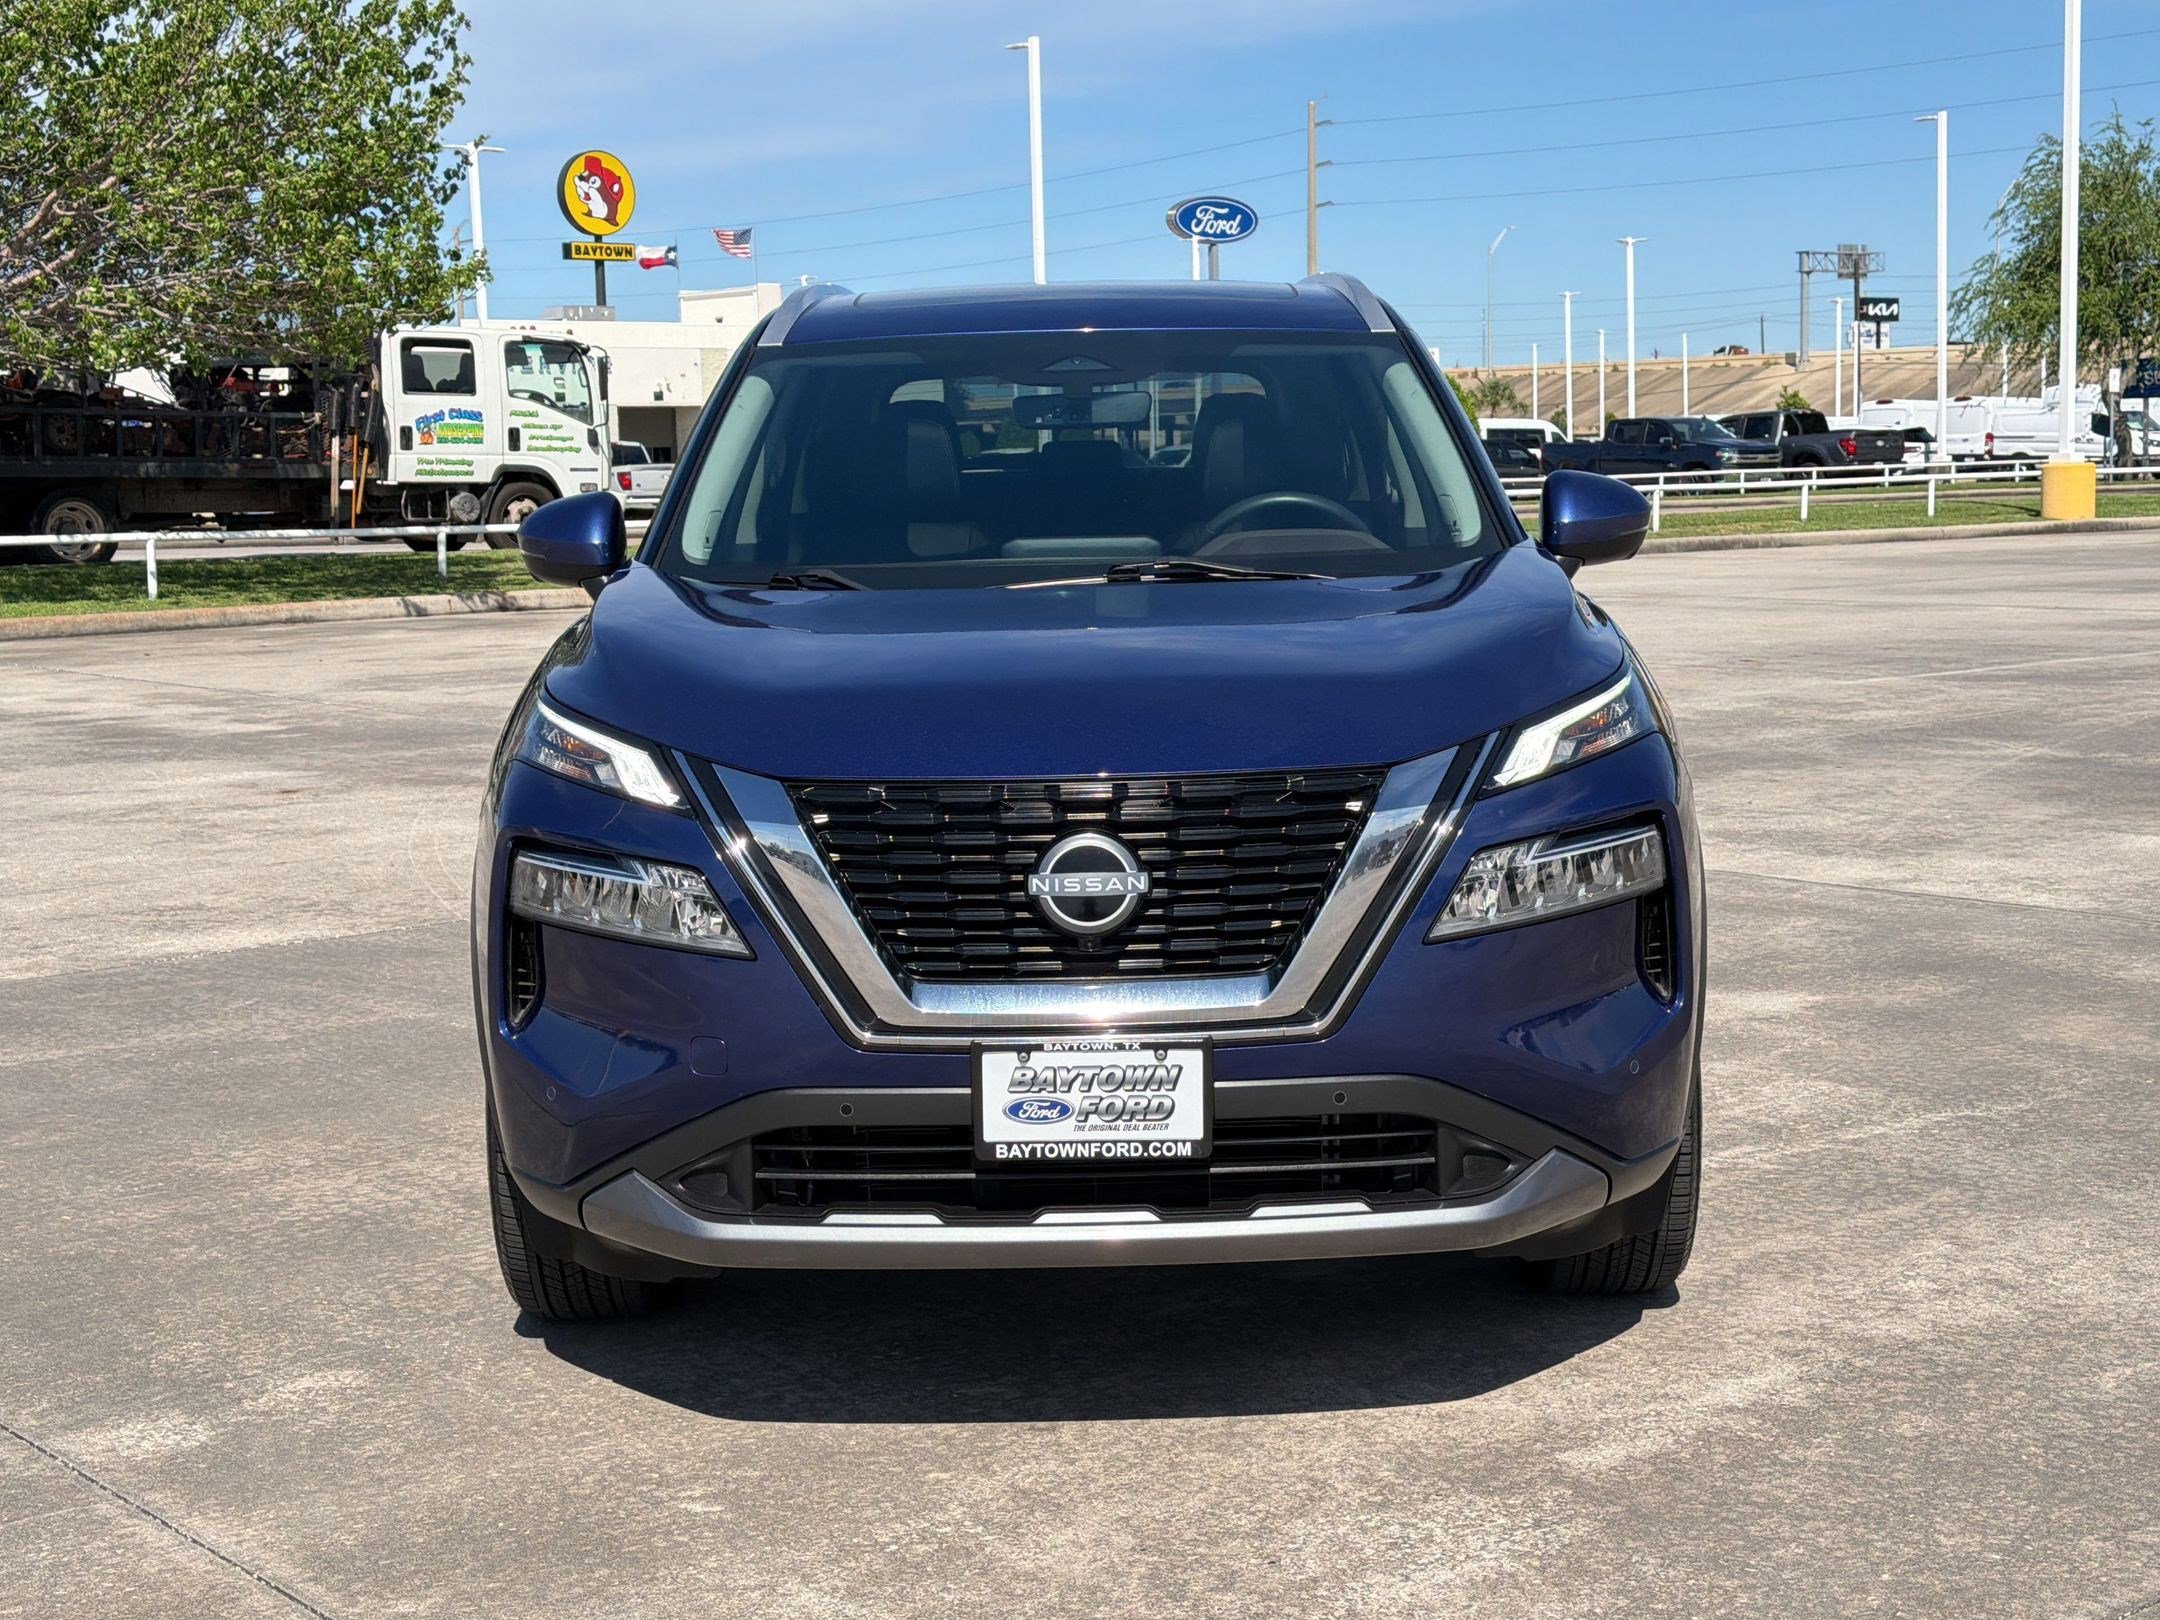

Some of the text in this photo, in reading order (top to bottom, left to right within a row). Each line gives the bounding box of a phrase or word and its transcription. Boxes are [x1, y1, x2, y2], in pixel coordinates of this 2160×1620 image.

[1191, 205, 1242, 235] Ford
[574, 244, 634, 258] BAYTOWN
[1867, 303, 1899, 317] KIA
[448, 408, 484, 422] Class
[1032, 876, 1145, 893] NISSAN
[1122, 1042, 1141, 1050] TX
[1008, 1065, 1183, 1094] BAYTOWN
[1018, 1095, 1176, 1123] Ford FORD
[1073, 1123, 1170, 1132] THE ORIGINAL DEAL BEATER
[995, 1142, 1193, 1159] BAYTOWNFORD.COM
